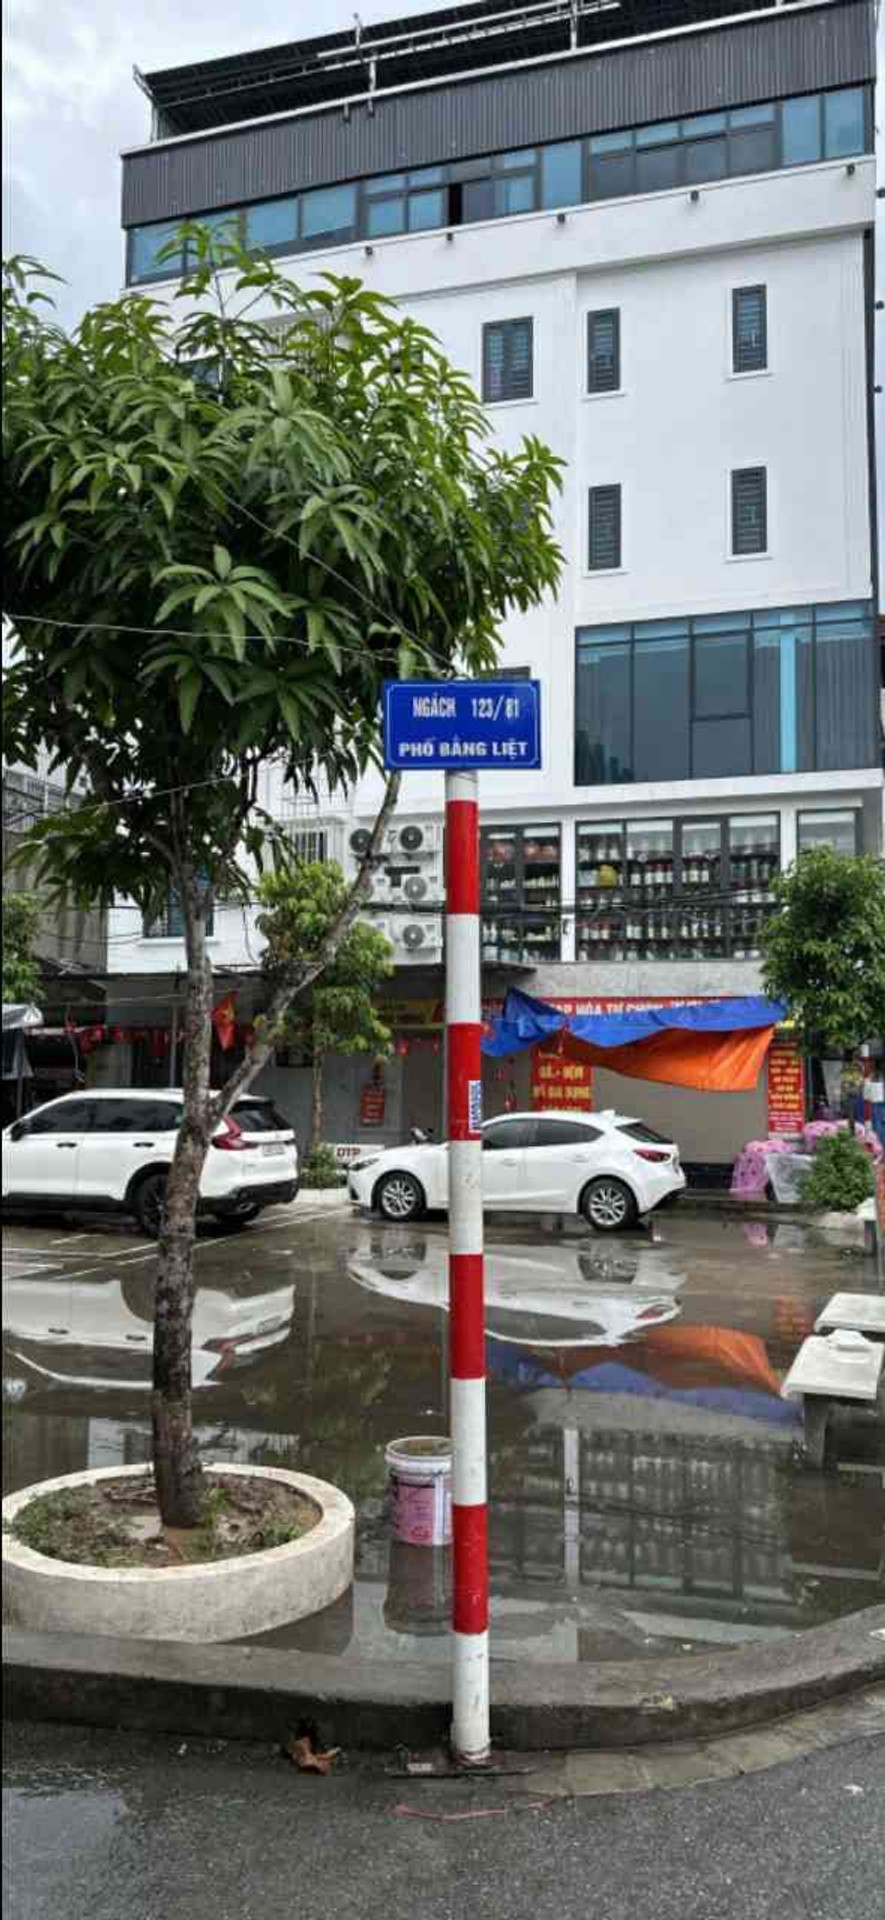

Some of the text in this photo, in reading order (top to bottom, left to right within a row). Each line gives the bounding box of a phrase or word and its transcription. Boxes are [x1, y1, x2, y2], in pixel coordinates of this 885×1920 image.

[412, 691, 457, 718] NGÁCH
[399, 736, 435, 757] PHỐ
[492, 737, 528, 760] LIỆT
